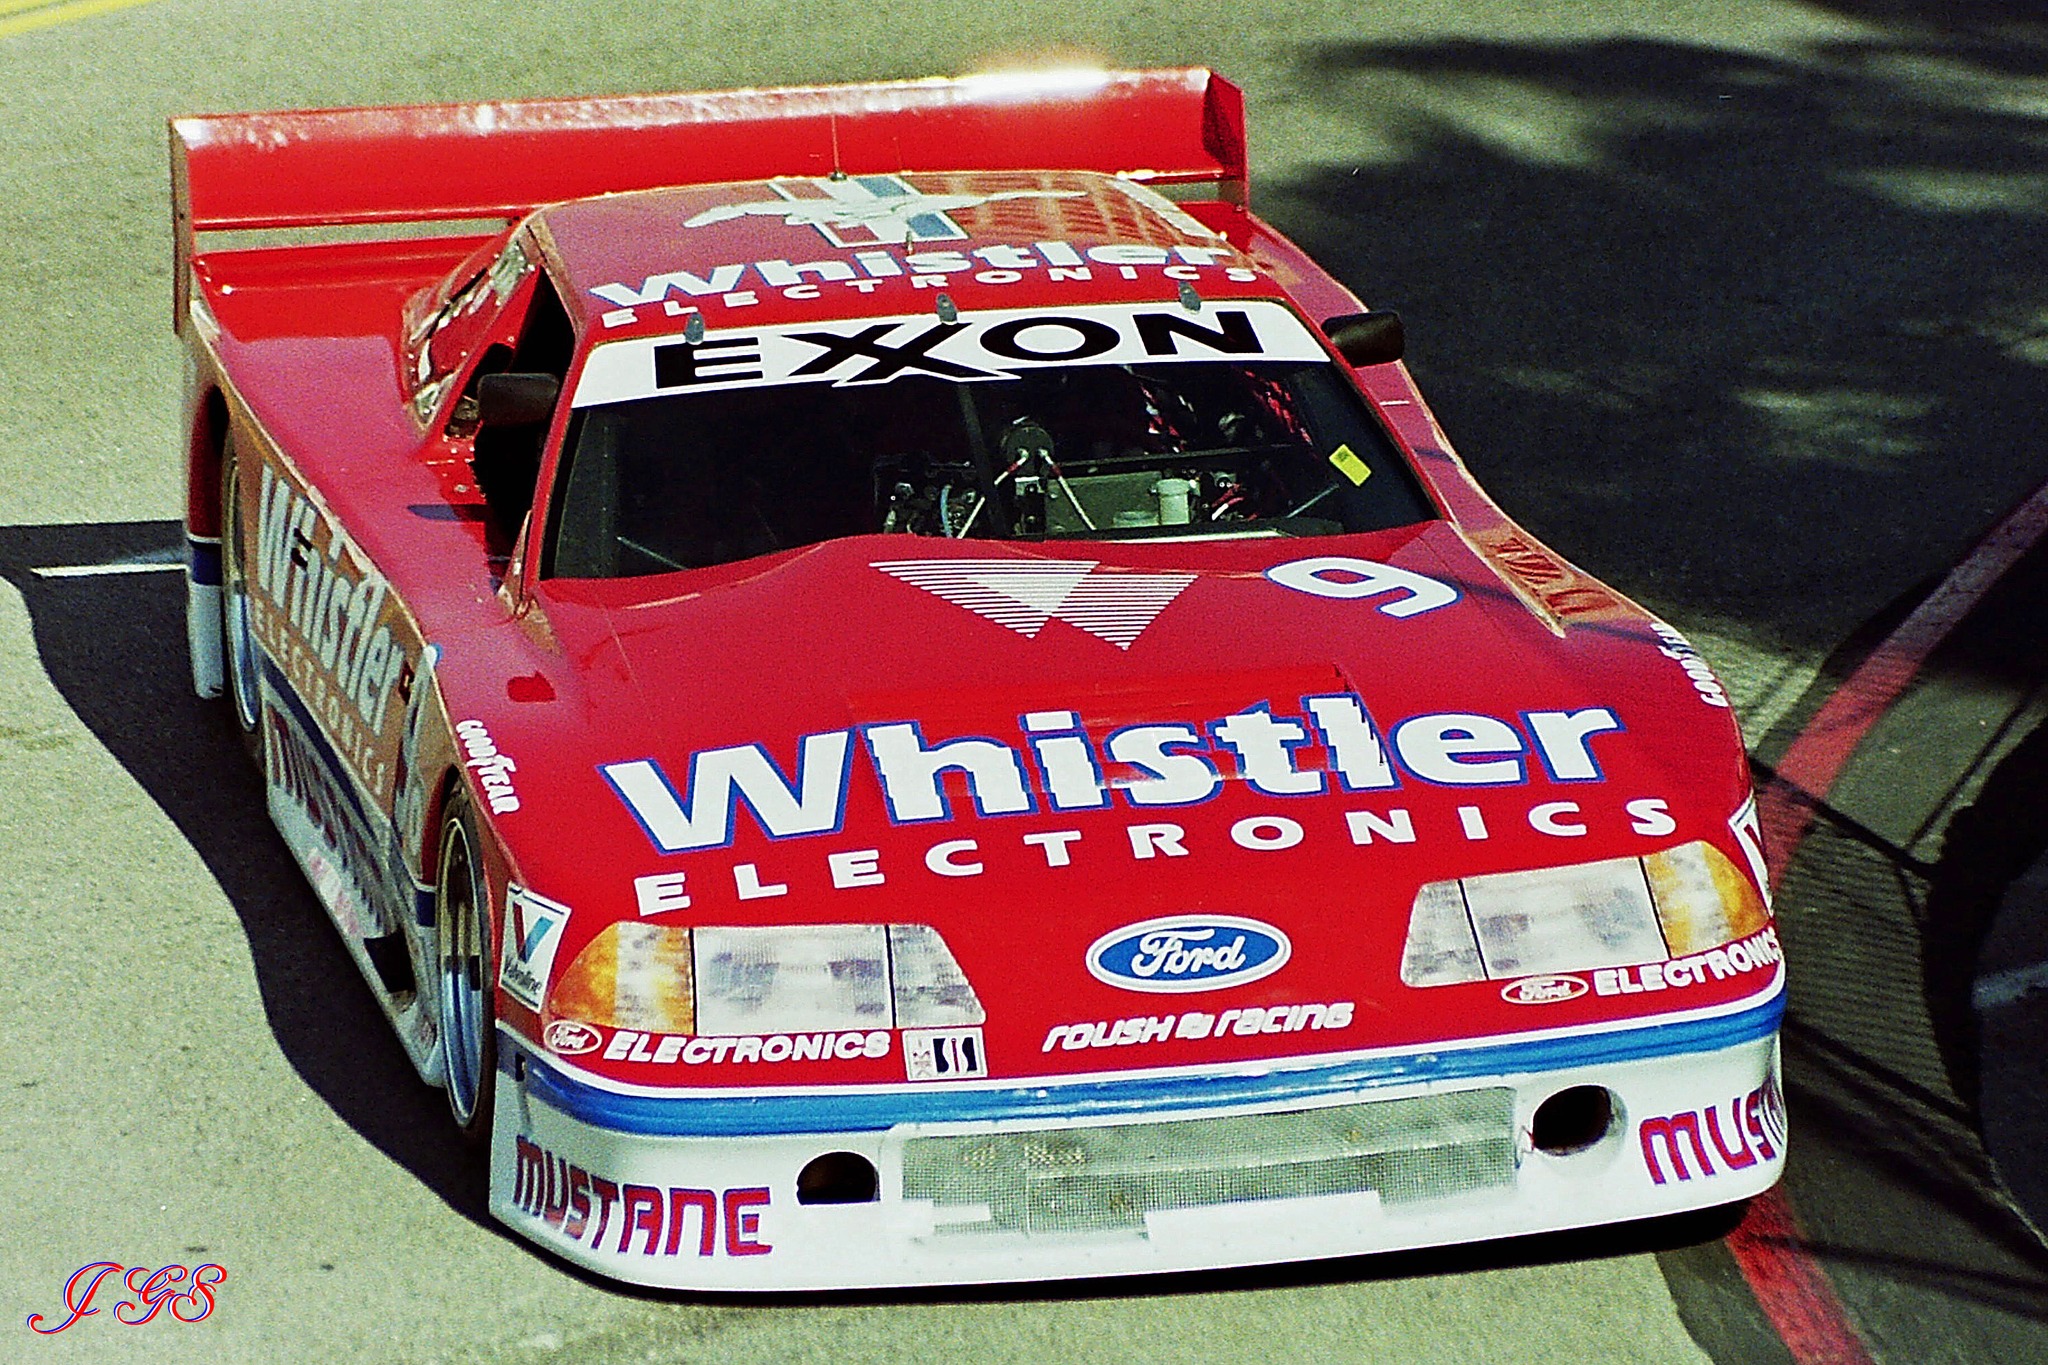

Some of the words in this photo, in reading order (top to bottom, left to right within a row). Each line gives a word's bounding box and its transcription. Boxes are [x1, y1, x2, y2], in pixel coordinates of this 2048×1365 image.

[587, 240, 1234, 307] Whistler
[602, 265, 1257, 328] ELECTRONICS
[654, 311, 1265, 389] EXXON
[456, 720, 520, 815] GOODYEAR
[599, 693, 1625, 855] Whistler
[633, 798, 1677, 917] ELECTRONICS
[1131, 928, 1247, 977] Ford
[602, 1030, 891, 1065] ELECTRONICS
